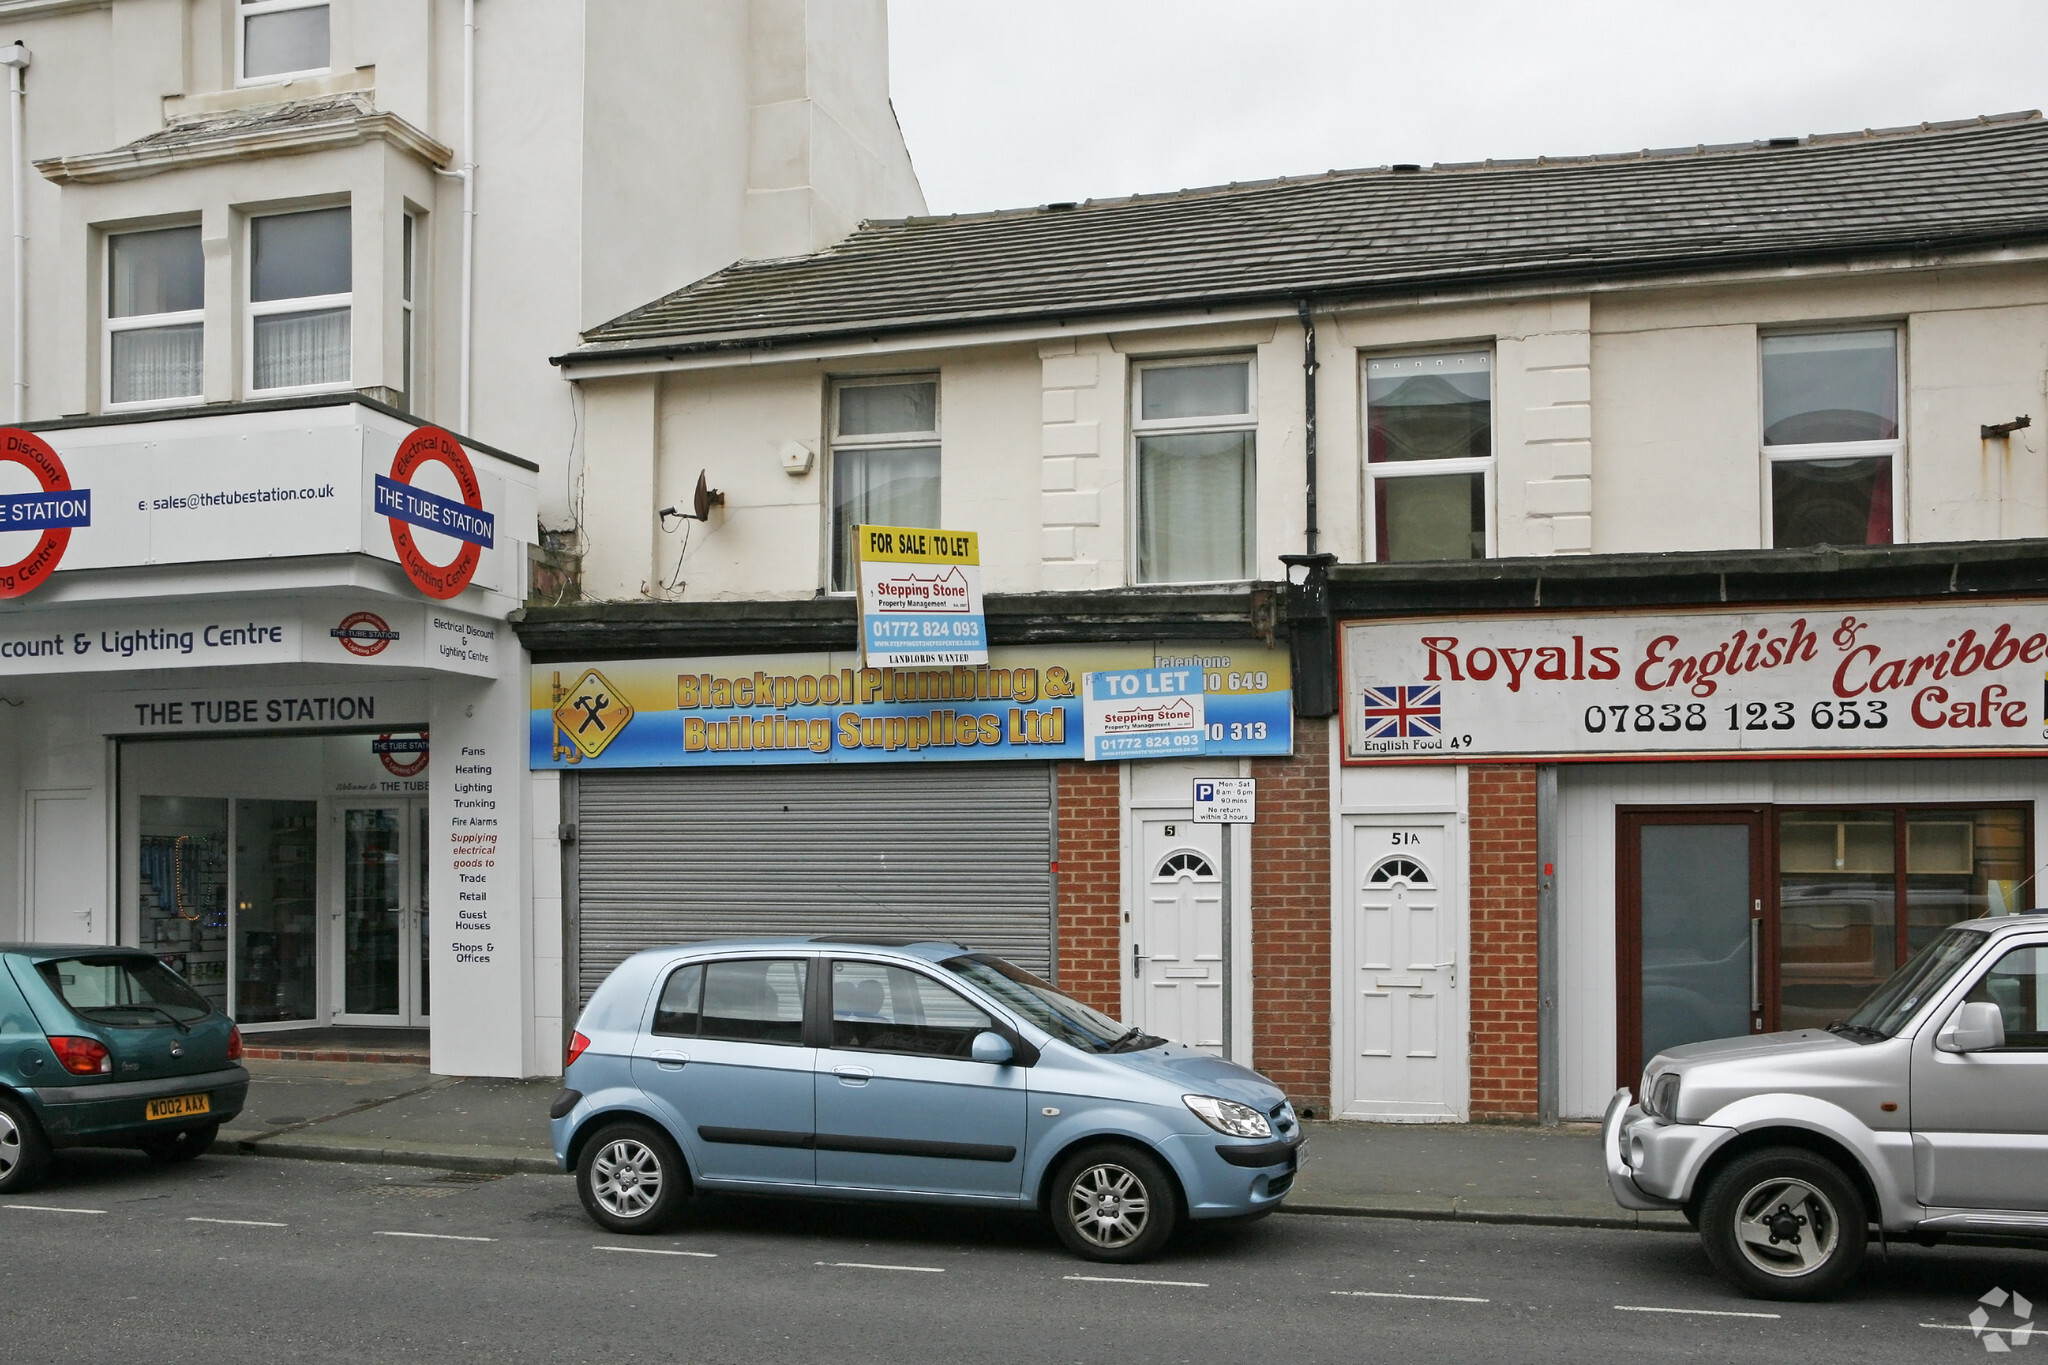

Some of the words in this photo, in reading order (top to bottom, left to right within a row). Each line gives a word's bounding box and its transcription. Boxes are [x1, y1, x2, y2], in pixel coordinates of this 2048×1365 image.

[8, 437, 61, 485] Discount
[398, 437, 438, 476] Electrical
[441, 440, 476, 499] Discount
[153, 484, 334, 509] sales@thetubestation.co.uk
[12, 500, 87, 521] STATION
[377, 485, 404, 510] THE
[407, 495, 440, 522] TUBE
[442, 508, 492, 539] STATION
[870, 533, 893, 553] FOR
[899, 534, 926, 554] SALE
[933, 536, 948, 556] TO
[950, 538, 969, 556] LET
[19, 538, 57, 582] Centre
[406, 550, 443, 592] Lighting
[446, 554, 472, 587] Centre
[878, 583, 930, 599] Stepping
[933, 584, 965, 597] Stone
[878, 600, 906, 608] Property
[907, 600, 947, 608] Management
[332, 629, 346, 637] THE
[349, 630, 367, 638] TUBE
[369, 631, 399, 639] STATION
[434, 618, 465, 634] Electrical
[466, 625, 495, 640] Discount
[873, 621, 919, 637] 01772
[923, 621, 949, 637] 824
[953, 621, 979, 637] 093
[1832, 615, 1868, 651] &
[1, 634, 64, 658] count
[73, 633, 91, 654] &
[101, 628, 194, 657] Lighting
[203, 622, 282, 647] Centre
[440, 645, 466, 660] Lighting
[468, 650, 489, 662] Centre
[889, 654, 936, 664] LANDLORDS
[938, 654, 969, 663] WANTED
[1634, 618, 1818, 698] English
[1832, 623, 2048, 699] Caribbe
[1420, 635, 1621, 693] Royals
[677, 668, 854, 709] Blackpool
[860, 665, 1038, 703] Plumbing
[1044, 665, 1074, 698] &
[1106, 675, 1140, 696] TO
[1146, 671, 1190, 693] LET
[1203, 672, 1222, 691] 10
[1228, 671, 1269, 691] 649
[134, 702, 183, 726] THE
[191, 700, 258, 723] TUBE
[266, 696, 374, 722] STATION
[1911, 684, 2028, 729] Cafe
[1105, 713, 1154, 724] Stepping
[1158, 711, 1191, 720] Stone
[1584, 702, 1707, 733] 07838
[1724, 701, 1796, 731] 123
[1811, 700, 1888, 730] 653
[683, 714, 832, 753] Building
[838, 709, 1002, 751] Supplies
[1007, 706, 1066, 744] Ltd
[1205, 723, 1224, 741] 10
[1230, 722, 1268, 741] 313
[374, 743, 387, 751] THE
[390, 742, 408, 750] TUBE
[1101, 738, 1142, 750] 01772
[1146, 736, 1170, 748] 824
[1174, 735, 1199, 746] 093
[1364, 739, 1409, 752] English
[1413, 739, 1443, 750] Food
[1450, 734, 1472, 749] 49
[461, 747, 486, 756] Fans
[455, 765, 492, 775] Heating
[381, 781, 400, 791] THE
[403, 781, 430, 790] TUBE
[455, 783, 493, 794] Lighting
[1200, 785, 1212, 800] P
[454, 799, 496, 809] Trunking
[452, 818, 467, 826] Fire
[470, 818, 498, 826] Alarms
[451, 833, 498, 844] Supplying
[1165, 826, 1174, 836] 5
[1391, 832, 1421, 845] 51A
[453, 846, 496, 855] electrical
[453, 859, 482, 870] goods
[485, 860, 495, 868] to
[459, 874, 486, 882] Trade
[459, 892, 487, 901] Retail
[459, 910, 487, 919] Guest
[455, 921, 491, 930] Houses
[452, 943, 483, 953] Shops
[456, 954, 491, 963] Offices
[186, 1095, 205, 1112] AAX
